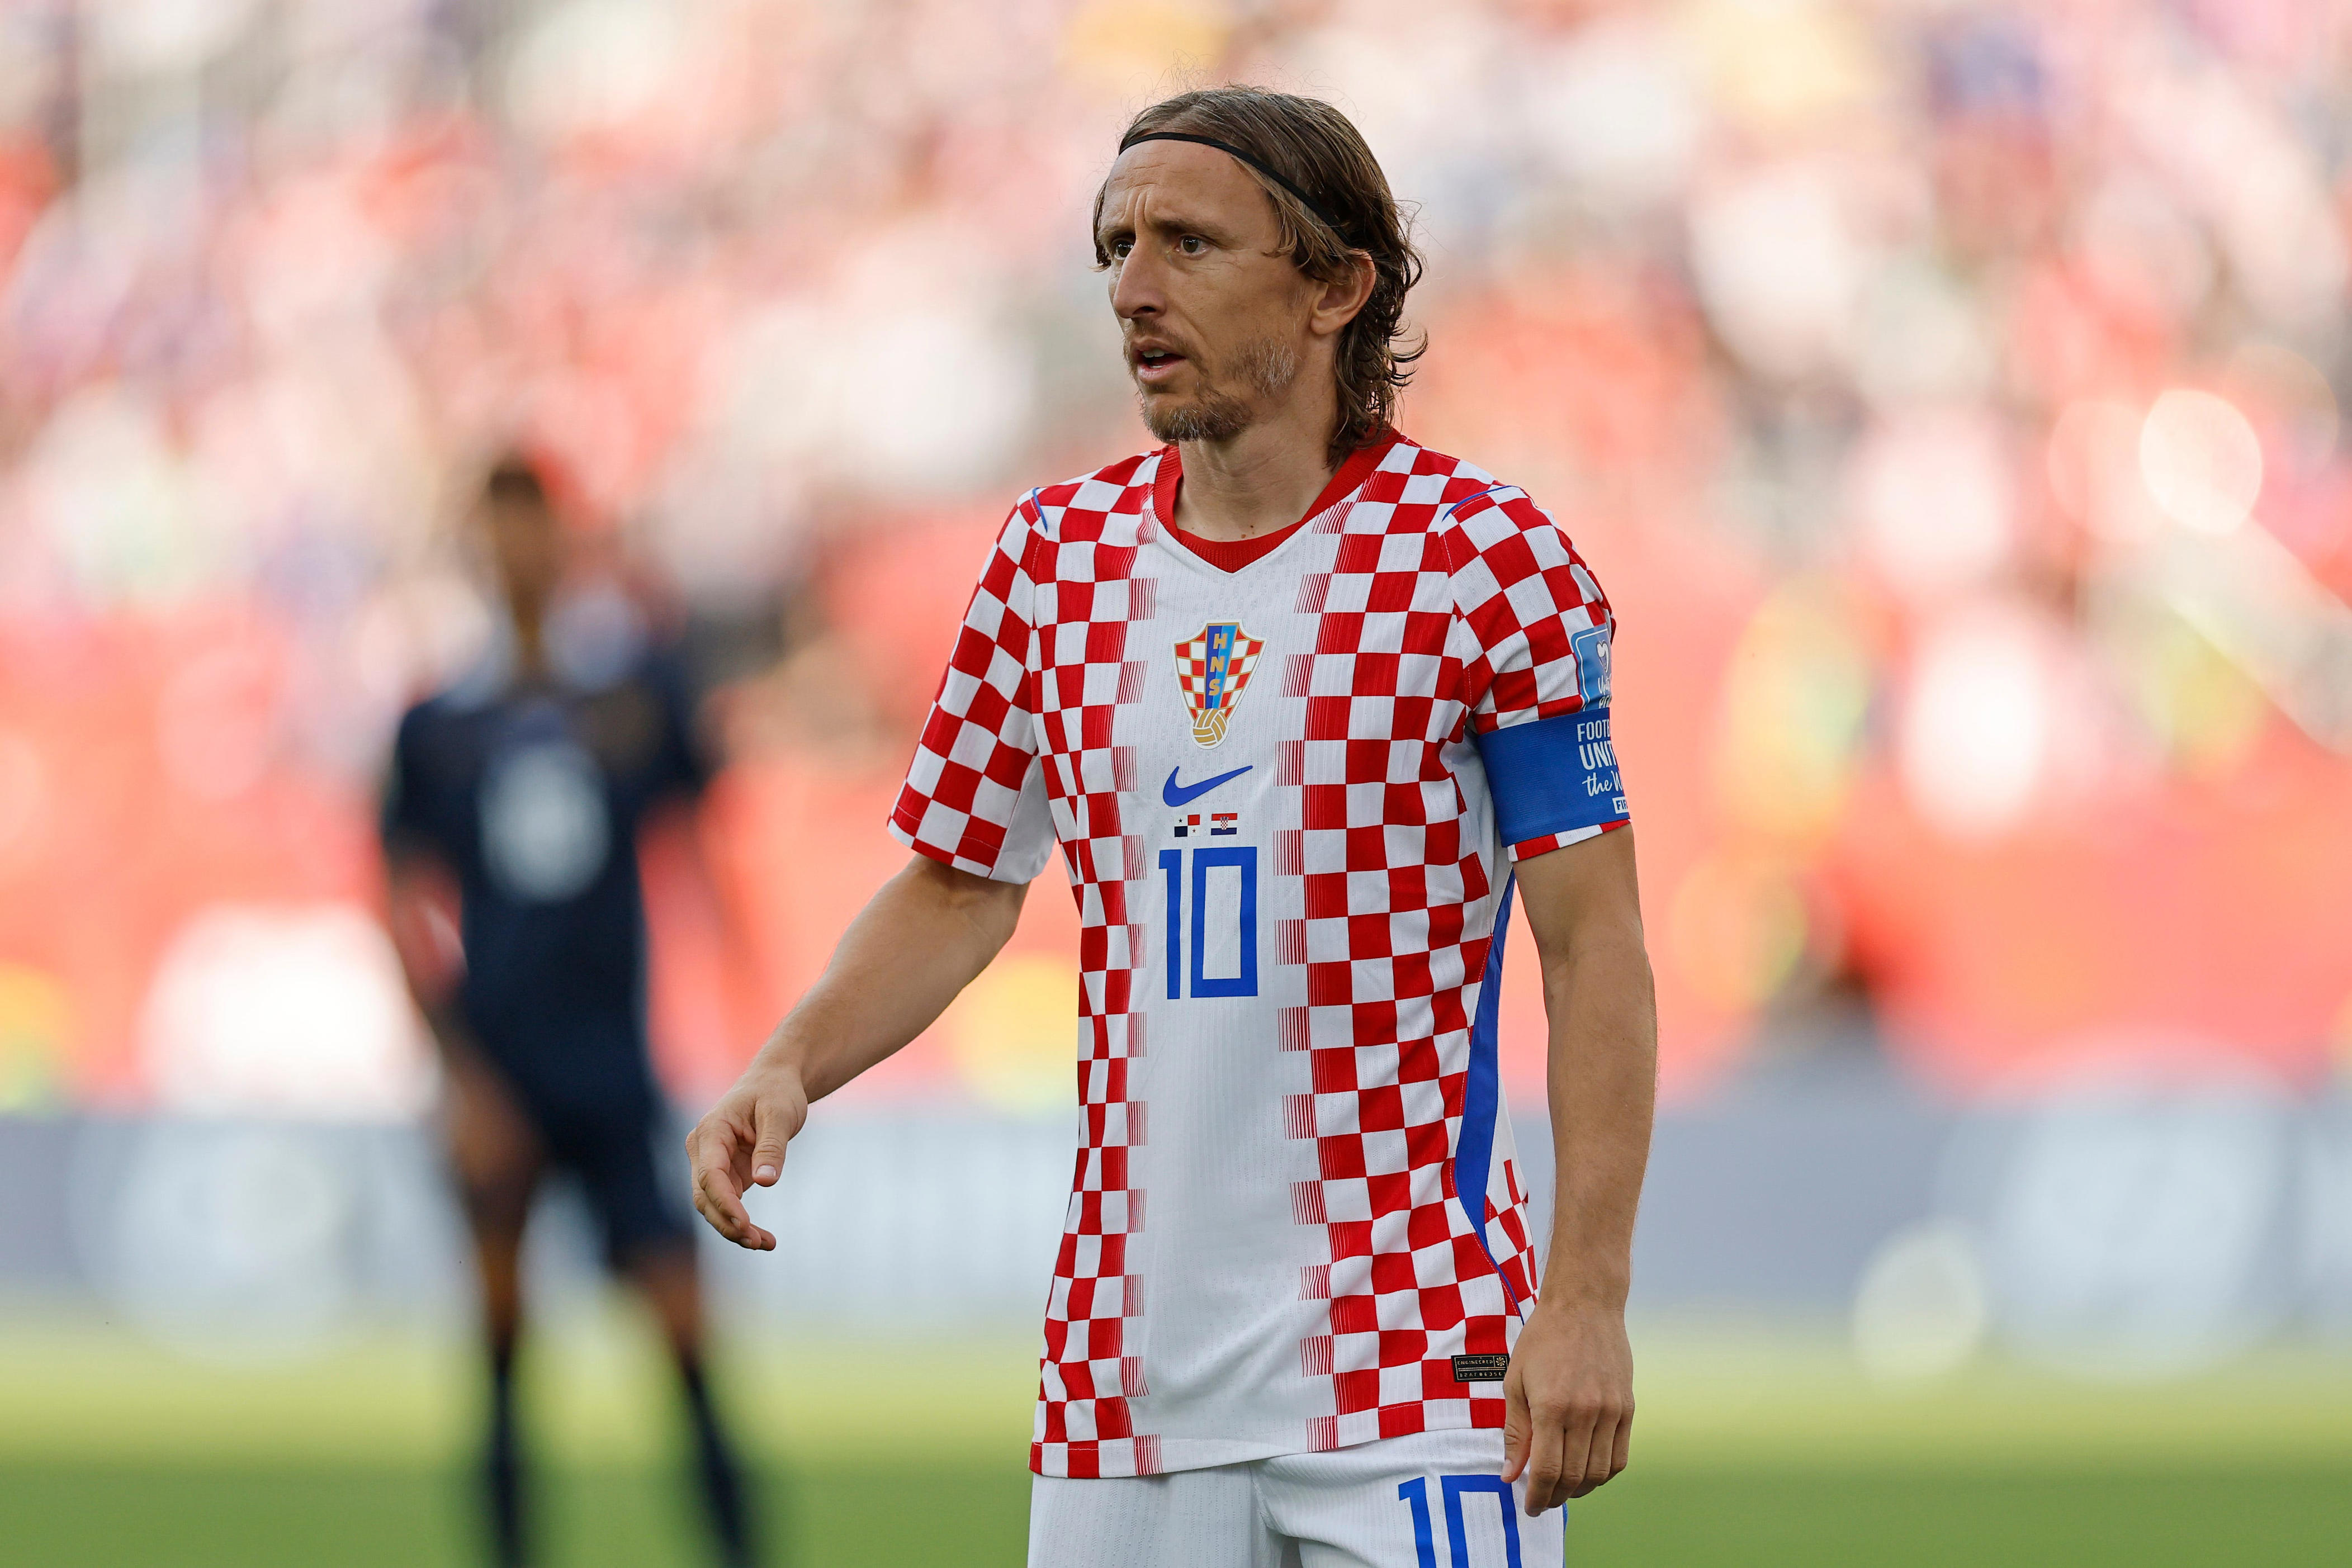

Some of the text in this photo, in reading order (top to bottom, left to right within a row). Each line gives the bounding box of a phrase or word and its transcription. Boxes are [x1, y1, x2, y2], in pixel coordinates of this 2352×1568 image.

[1209, 633, 1228, 696] HNS
[1582, 772, 1613, 797] the
[1616, 799, 1627, 811] FIF
[1158, 846, 1258, 999] 10
[1398, 1474, 1522, 1568] 10
